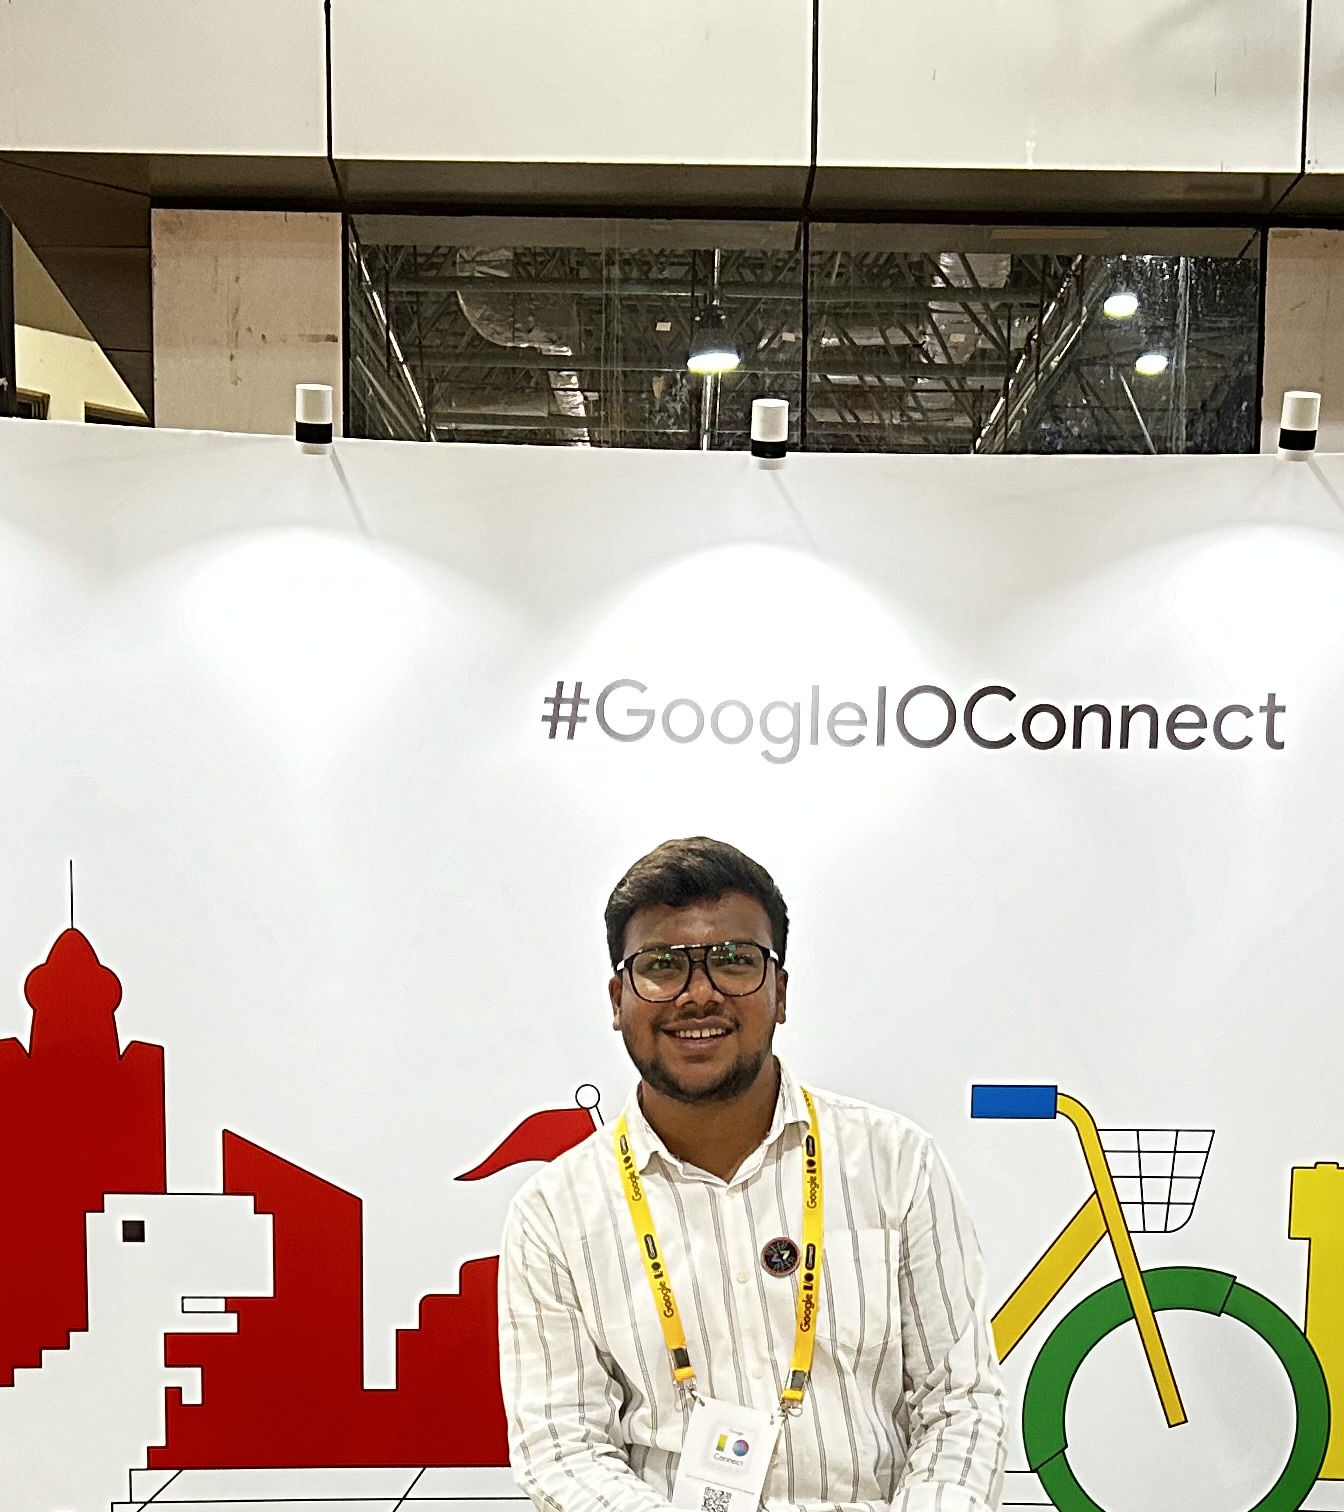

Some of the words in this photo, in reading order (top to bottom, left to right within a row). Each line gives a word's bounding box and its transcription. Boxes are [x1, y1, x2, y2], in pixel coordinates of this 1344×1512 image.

[541, 679, 1287, 765] #GoogleIOConnect
[806, 1176, 820, 1209] Google
[657, 1281, 674, 1318] Google
[800, 1294, 815, 1332] Google
